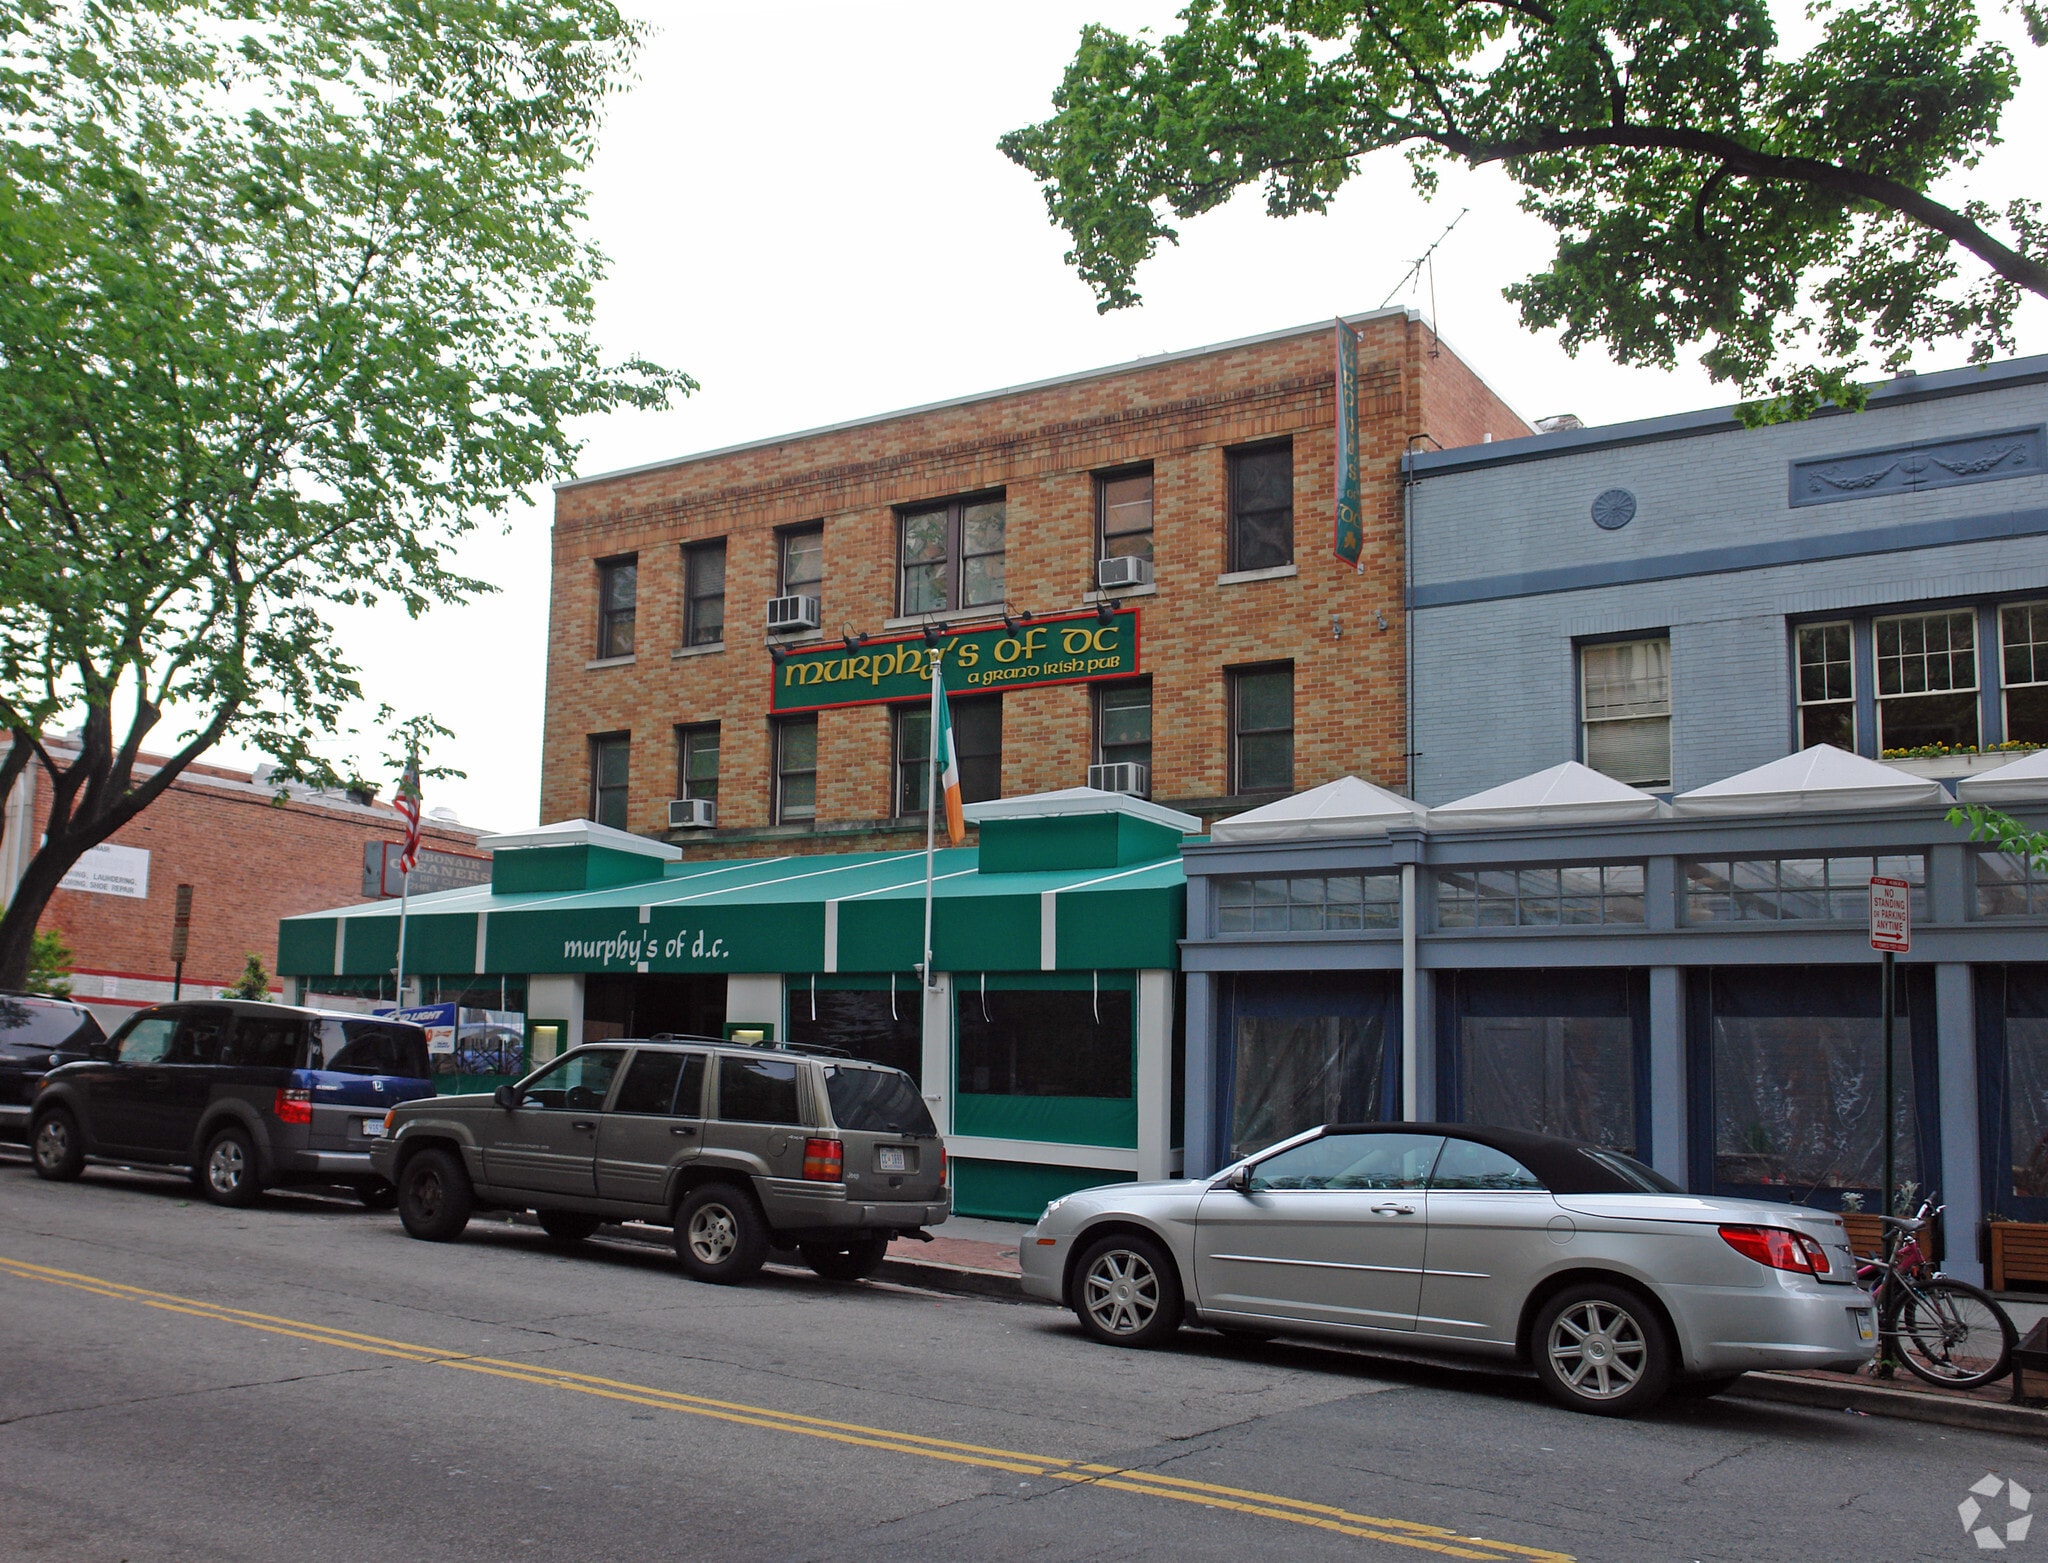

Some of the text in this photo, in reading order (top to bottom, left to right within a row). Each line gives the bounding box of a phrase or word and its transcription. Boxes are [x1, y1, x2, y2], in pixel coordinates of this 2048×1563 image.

[1060, 626, 1119, 654] DC
[418, 853, 480, 870] EBONAIR
[389, 858, 491, 882] CEANERS
[420, 875, 438, 883] DRY
[89, 881, 107, 891] SHOE
[111, 884, 134, 893] REPAIR
[1884, 888, 1894, 897] NO
[1874, 897, 1905, 910] STANDING
[1881, 909, 1906, 921] PARKING
[1876, 920, 1903, 931] ANYTIME
[564, 929, 729, 966] murphy's of d.c.
[411, 1010, 444, 1021] LIGHT
[847, 1171, 860, 1180] Jeep
